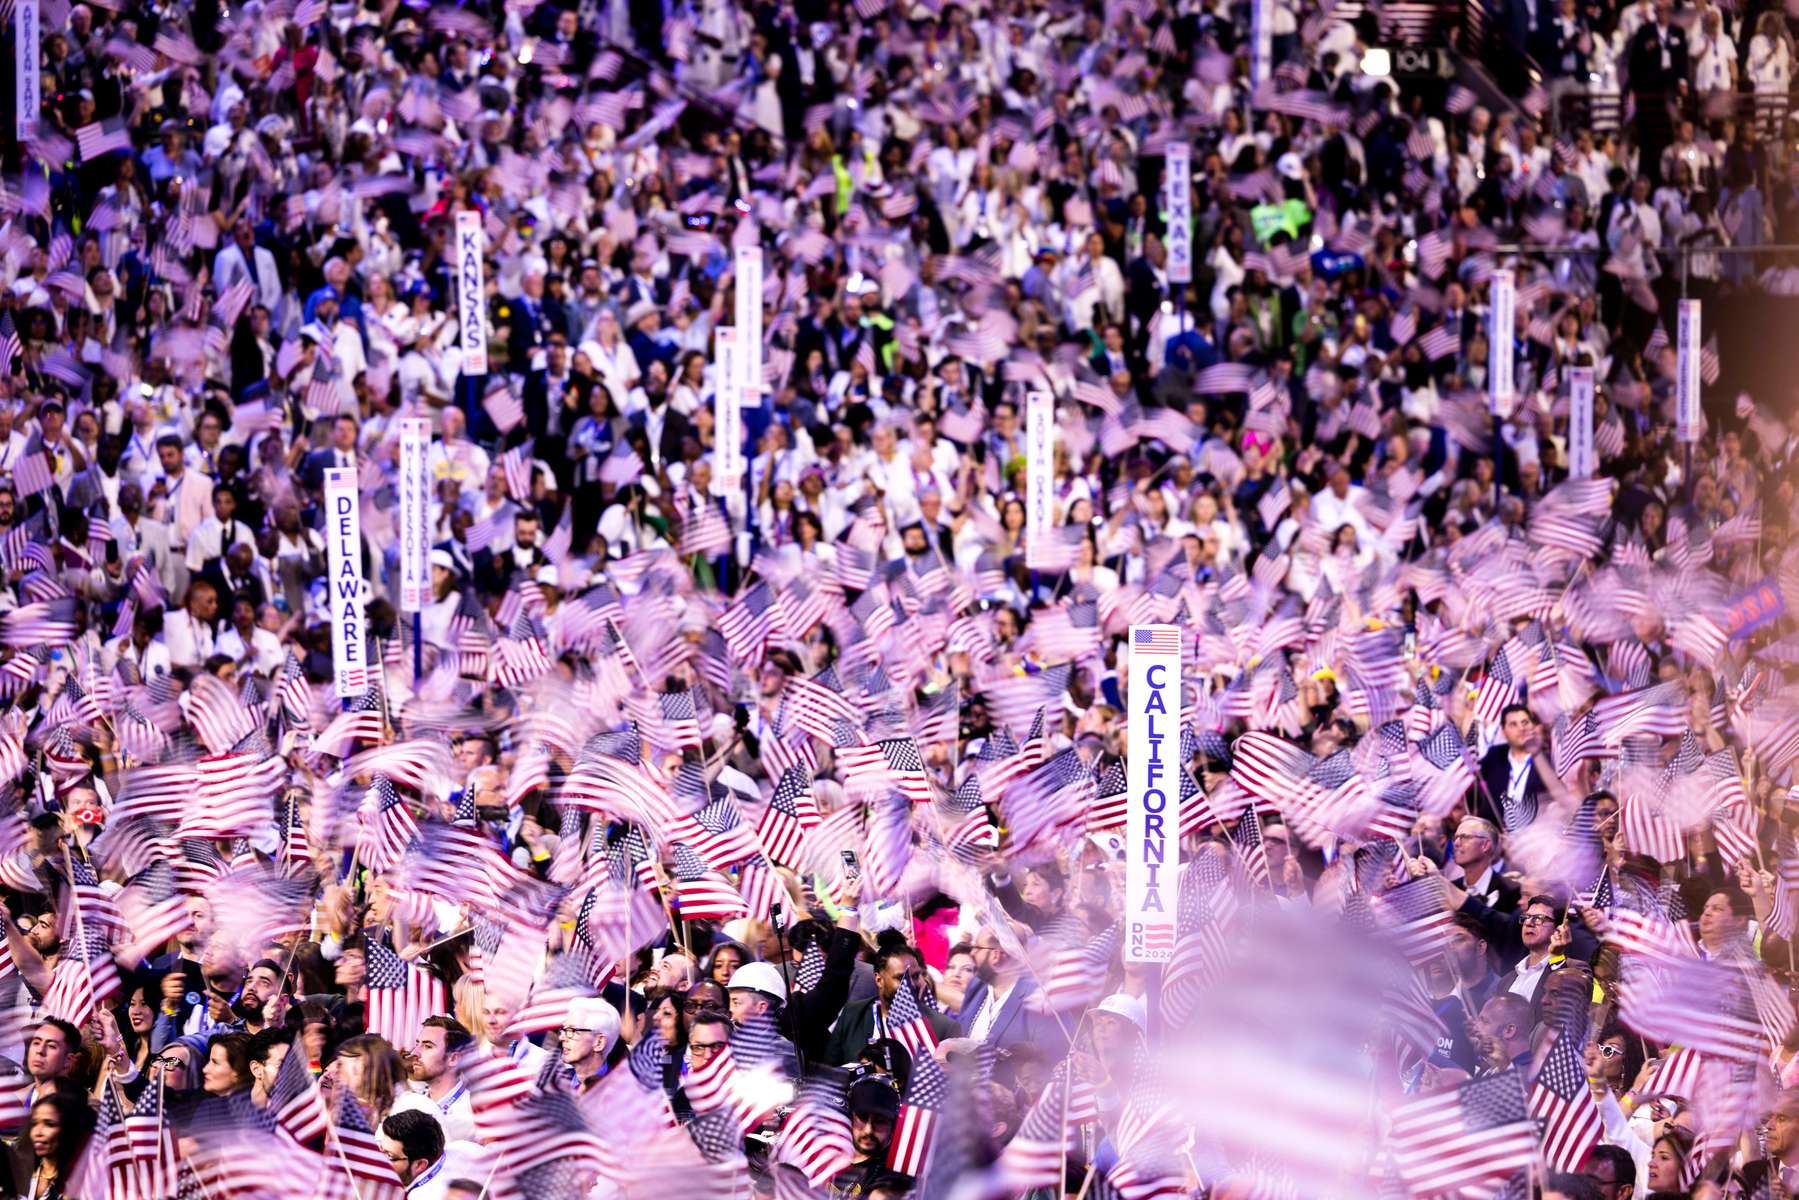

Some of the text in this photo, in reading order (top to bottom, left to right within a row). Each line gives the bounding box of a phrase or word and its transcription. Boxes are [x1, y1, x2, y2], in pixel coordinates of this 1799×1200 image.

[1396, 50, 1430, 72] 104
[1173, 160, 1186, 262] TEXAS
[462, 231, 481, 349] KANSAS
[405, 442, 414, 583] MINNESOTA
[420, 442, 429, 583] MINNESOTA
[337, 496, 359, 662] DELAWARE
[1140, 664, 1168, 913] CALIFORNIA
[1131, 922, 1144, 957] DNC
